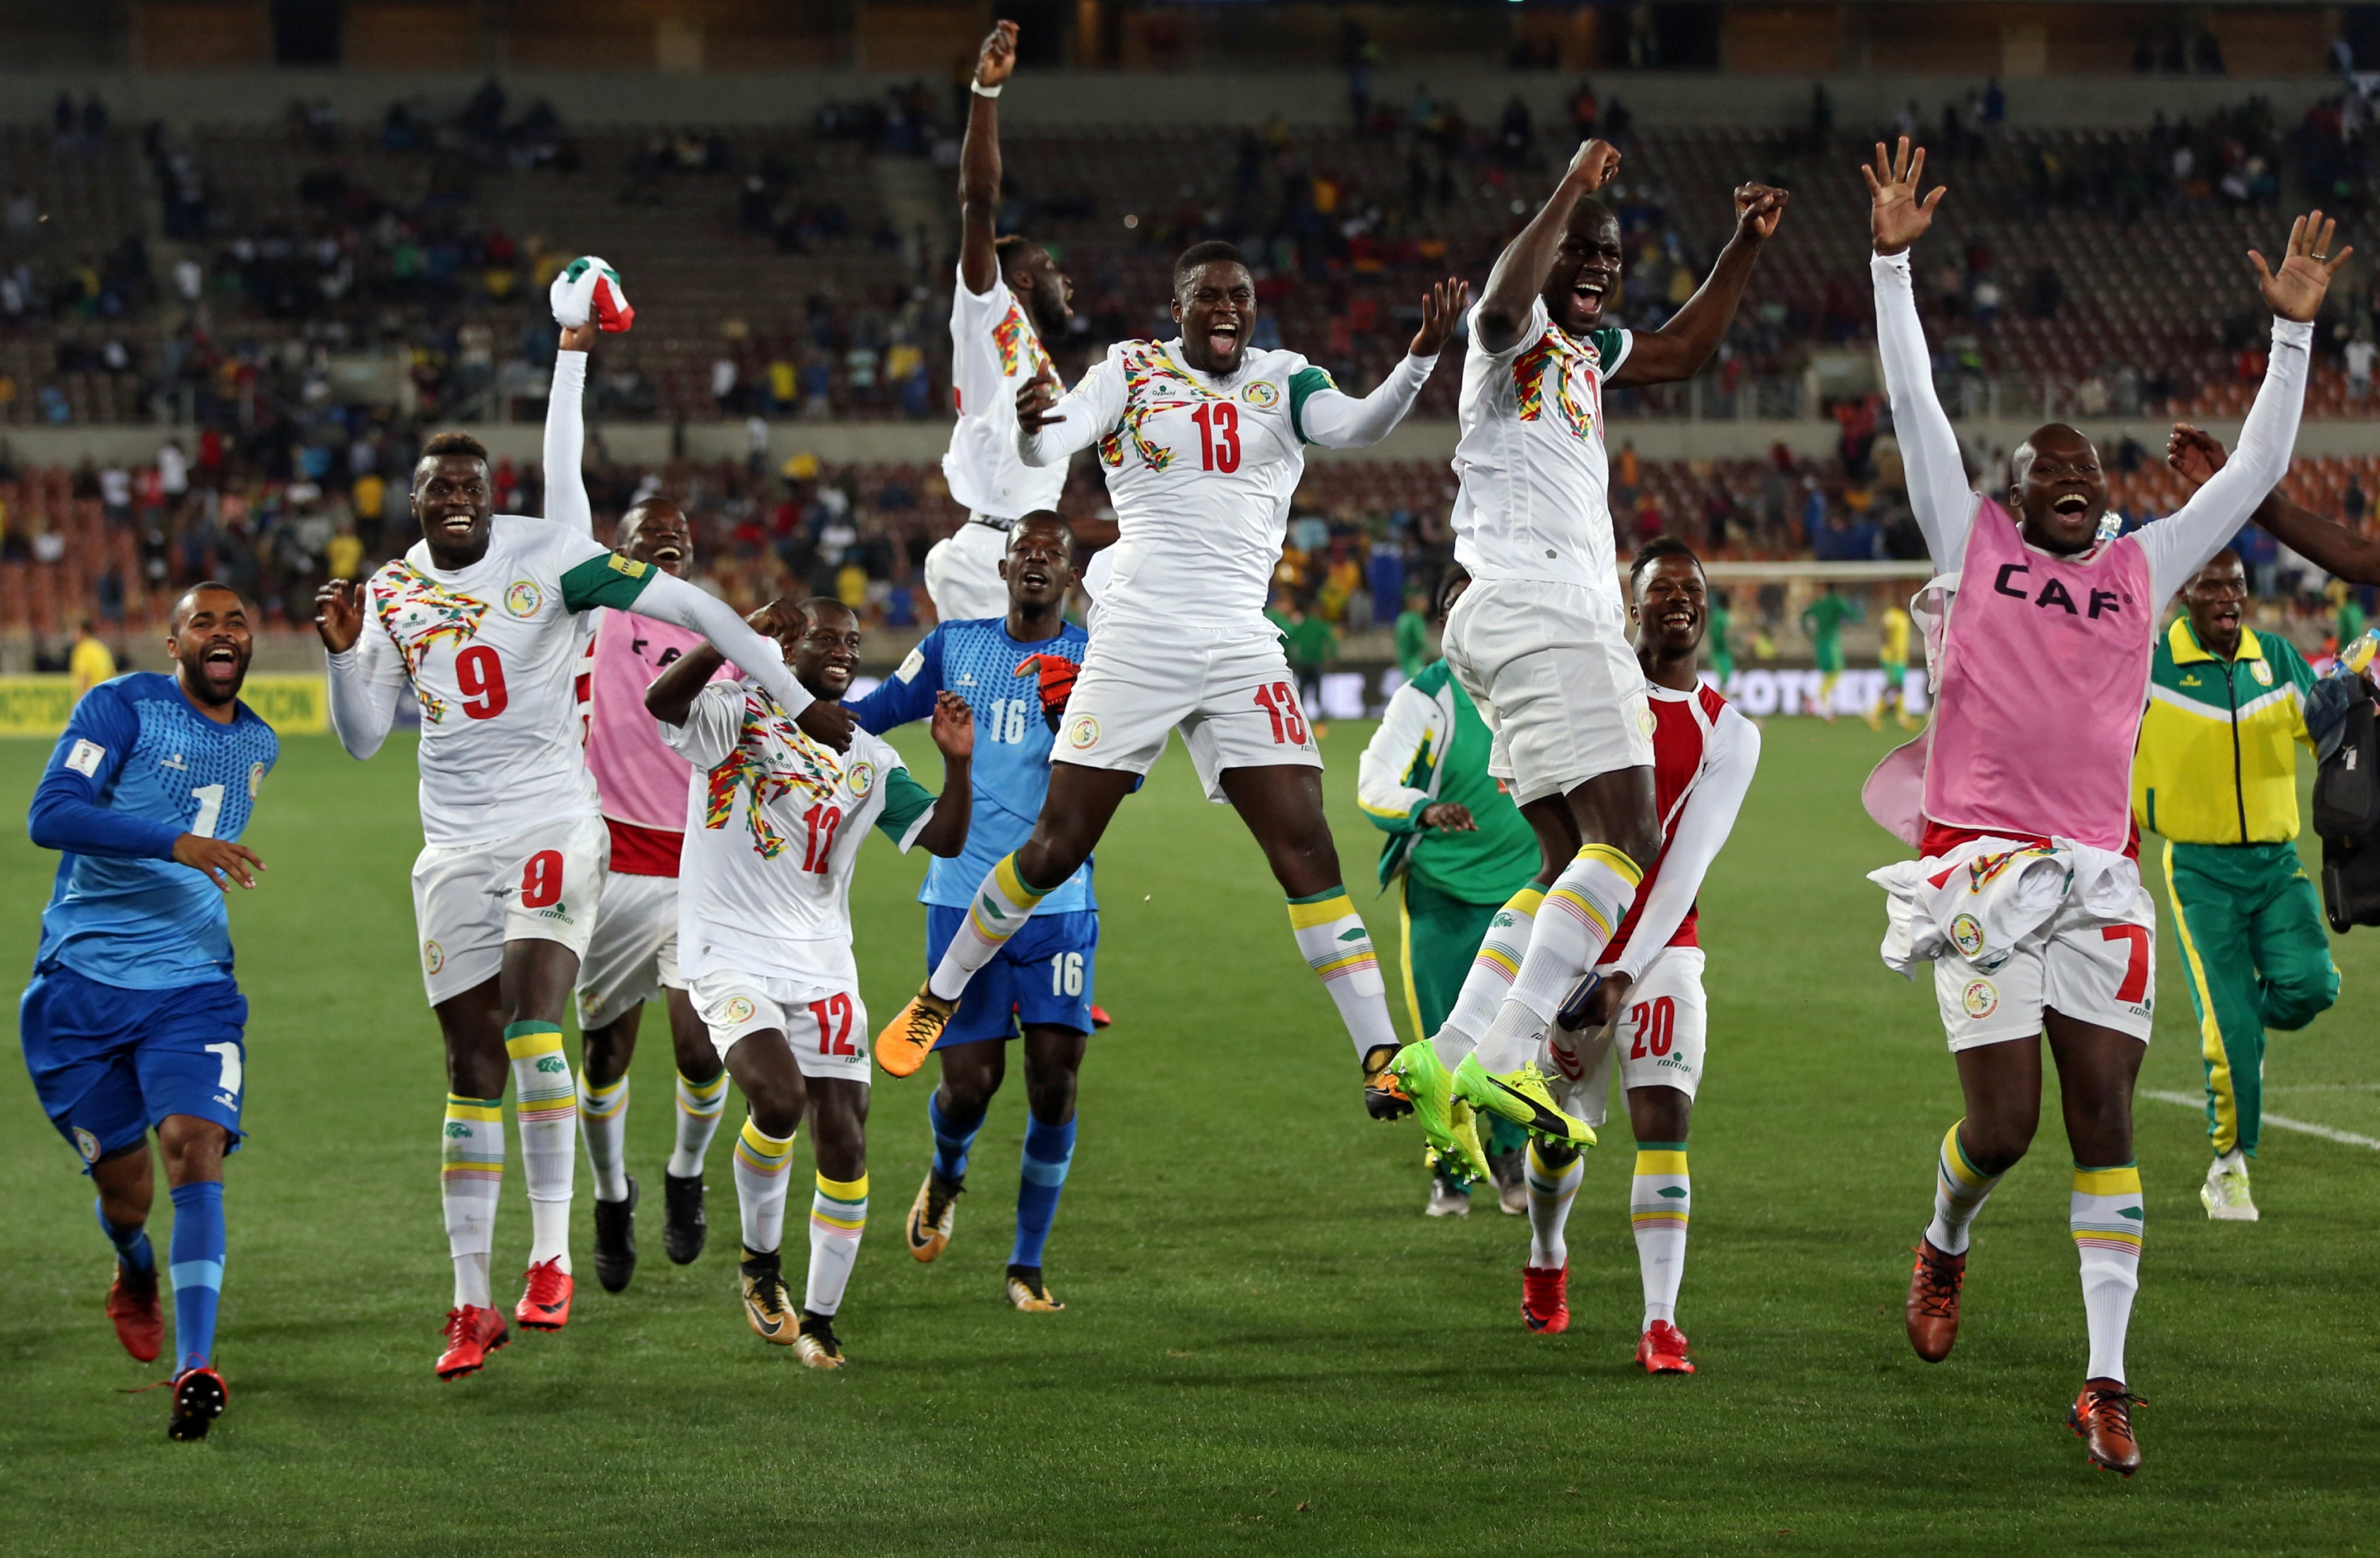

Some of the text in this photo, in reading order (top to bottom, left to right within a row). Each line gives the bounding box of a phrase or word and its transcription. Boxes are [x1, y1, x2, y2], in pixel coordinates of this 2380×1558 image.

[1192, 402, 1241, 474] 13
[455, 645, 508, 720] 9
[1253, 681, 1307, 745] 13
[990, 698, 1027, 744] 16
[191, 784, 225, 838] 1
[802, 803, 841, 874] 12
[539, 910, 574, 926] romai
[1050, 951, 1084, 997] 16
[2102, 924, 2148, 1003] 7
[808, 992, 855, 1056] 12
[1630, 996, 1675, 1061] 20
[205, 1041, 242, 1096] 1
[1656, 1059, 1692, 1073] romai
